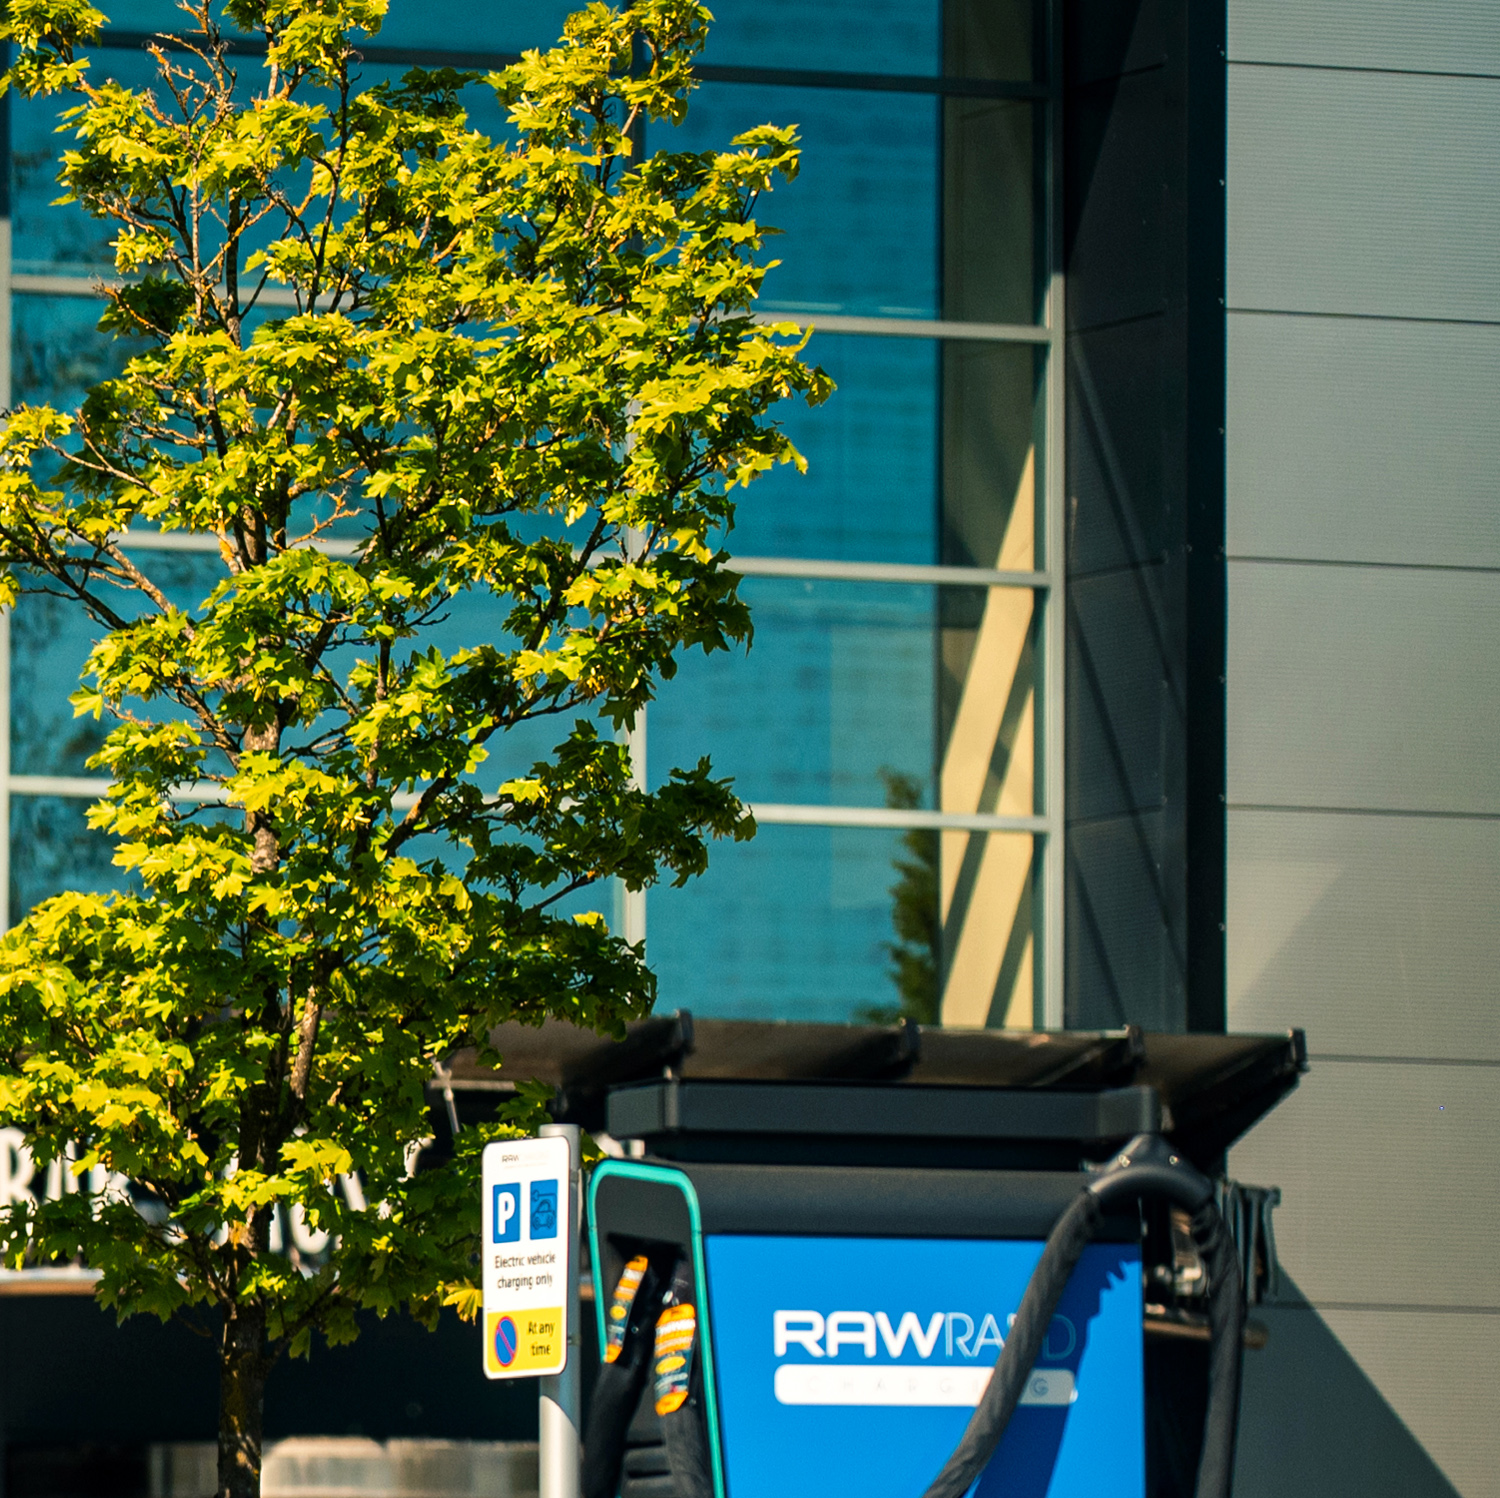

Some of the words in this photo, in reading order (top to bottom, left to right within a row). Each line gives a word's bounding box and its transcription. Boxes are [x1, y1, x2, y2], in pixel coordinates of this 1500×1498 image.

[497, 1191, 516, 1235] P
[495, 1254, 525, 1269] Electric
[527, 1251, 556, 1266] vehicle
[497, 1274, 533, 1291] charging
[536, 1271, 553, 1288] only
[529, 1321, 538, 1335] At
[539, 1321, 555, 1337] any
[531, 1342, 551, 1356] time
